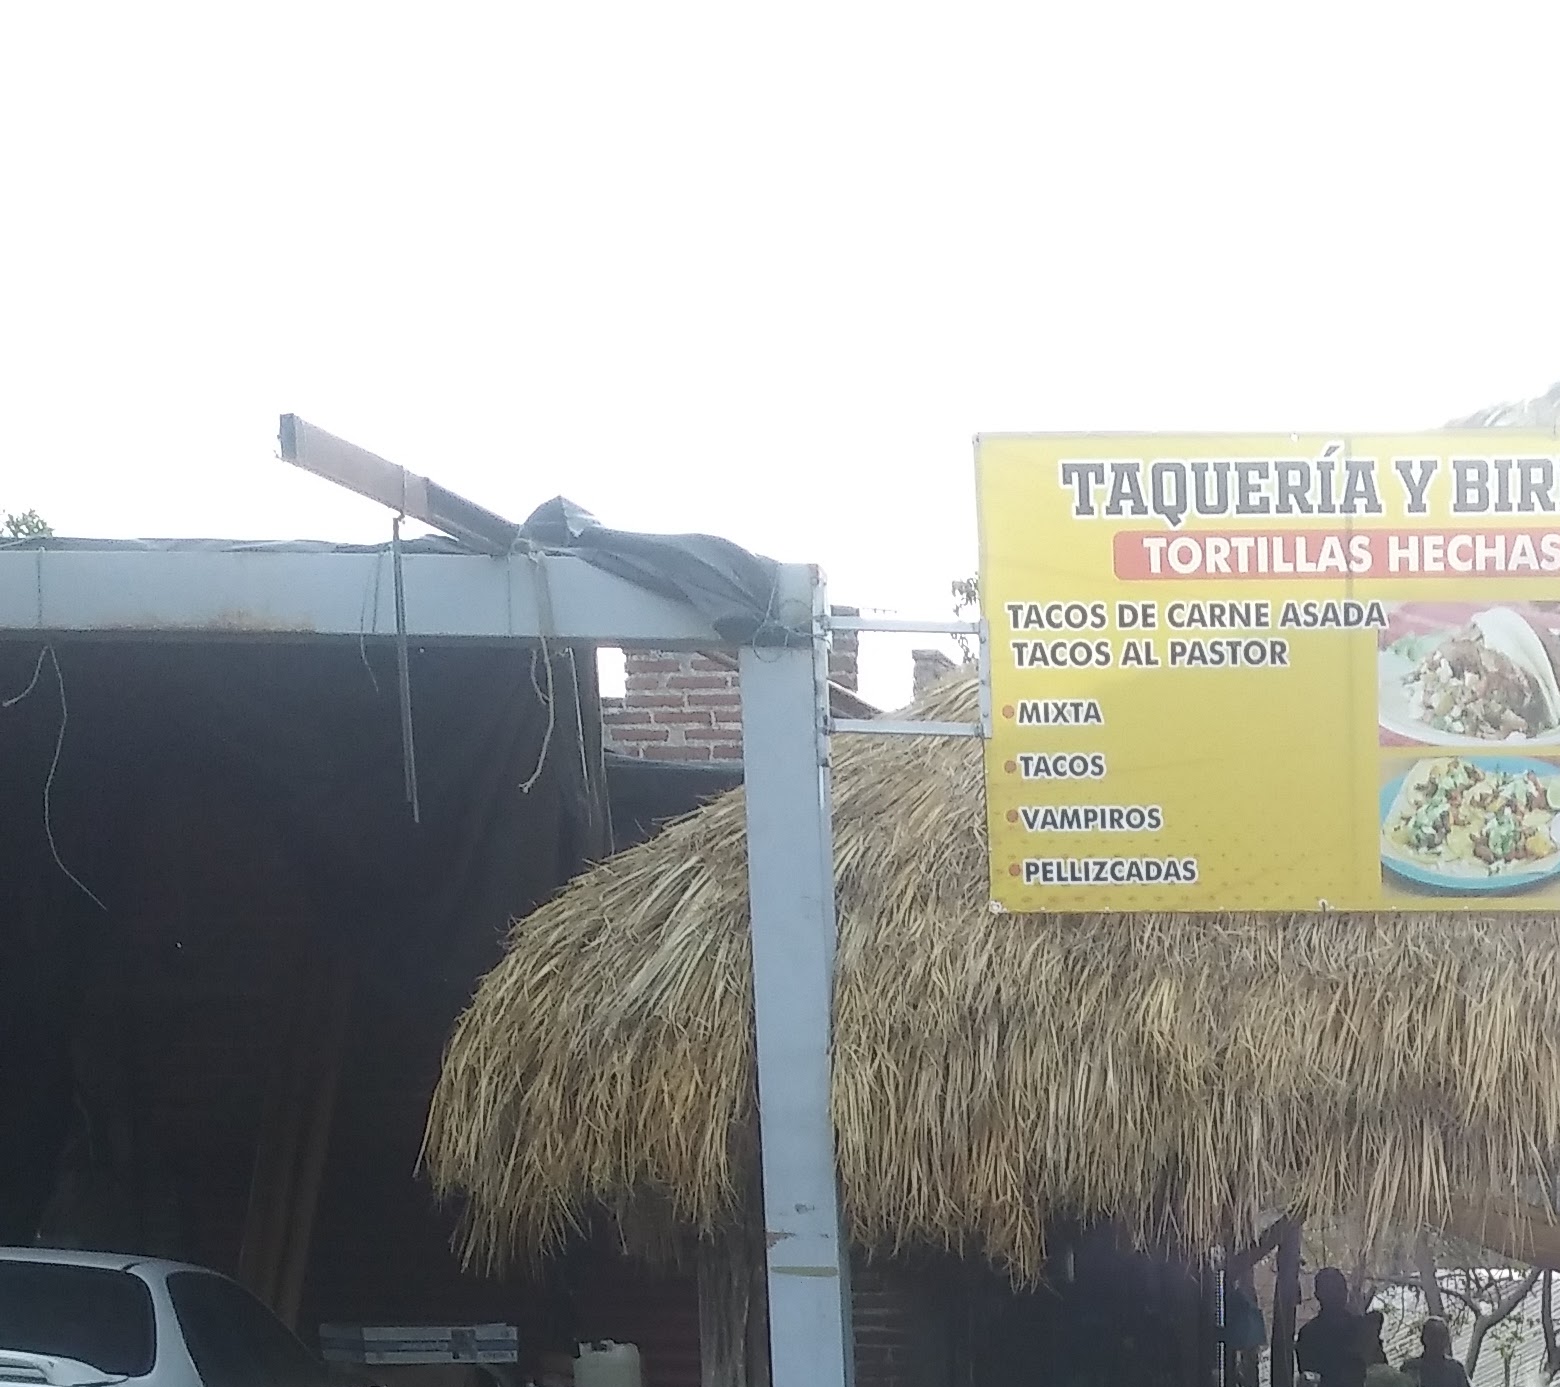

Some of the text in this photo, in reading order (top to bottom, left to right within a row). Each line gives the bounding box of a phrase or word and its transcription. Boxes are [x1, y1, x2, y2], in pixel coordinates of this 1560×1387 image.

[1060, 444, 1383, 528] TAQUERÍA
[1395, 459, 1438, 514] Y
[1142, 535, 1373, 575] TORTILLAS
[1006, 601, 1388, 629] TACOS DE CARNE ASADA
[1011, 639, 1289, 667] TACOS AL PASTOR
[1017, 701, 1103, 725] MIXTA
[1019, 755, 1105, 777] TACOS
[1020, 807, 1162, 830] VAMPIROS
[1024, 860, 1197, 883] PELLIZCADAS
